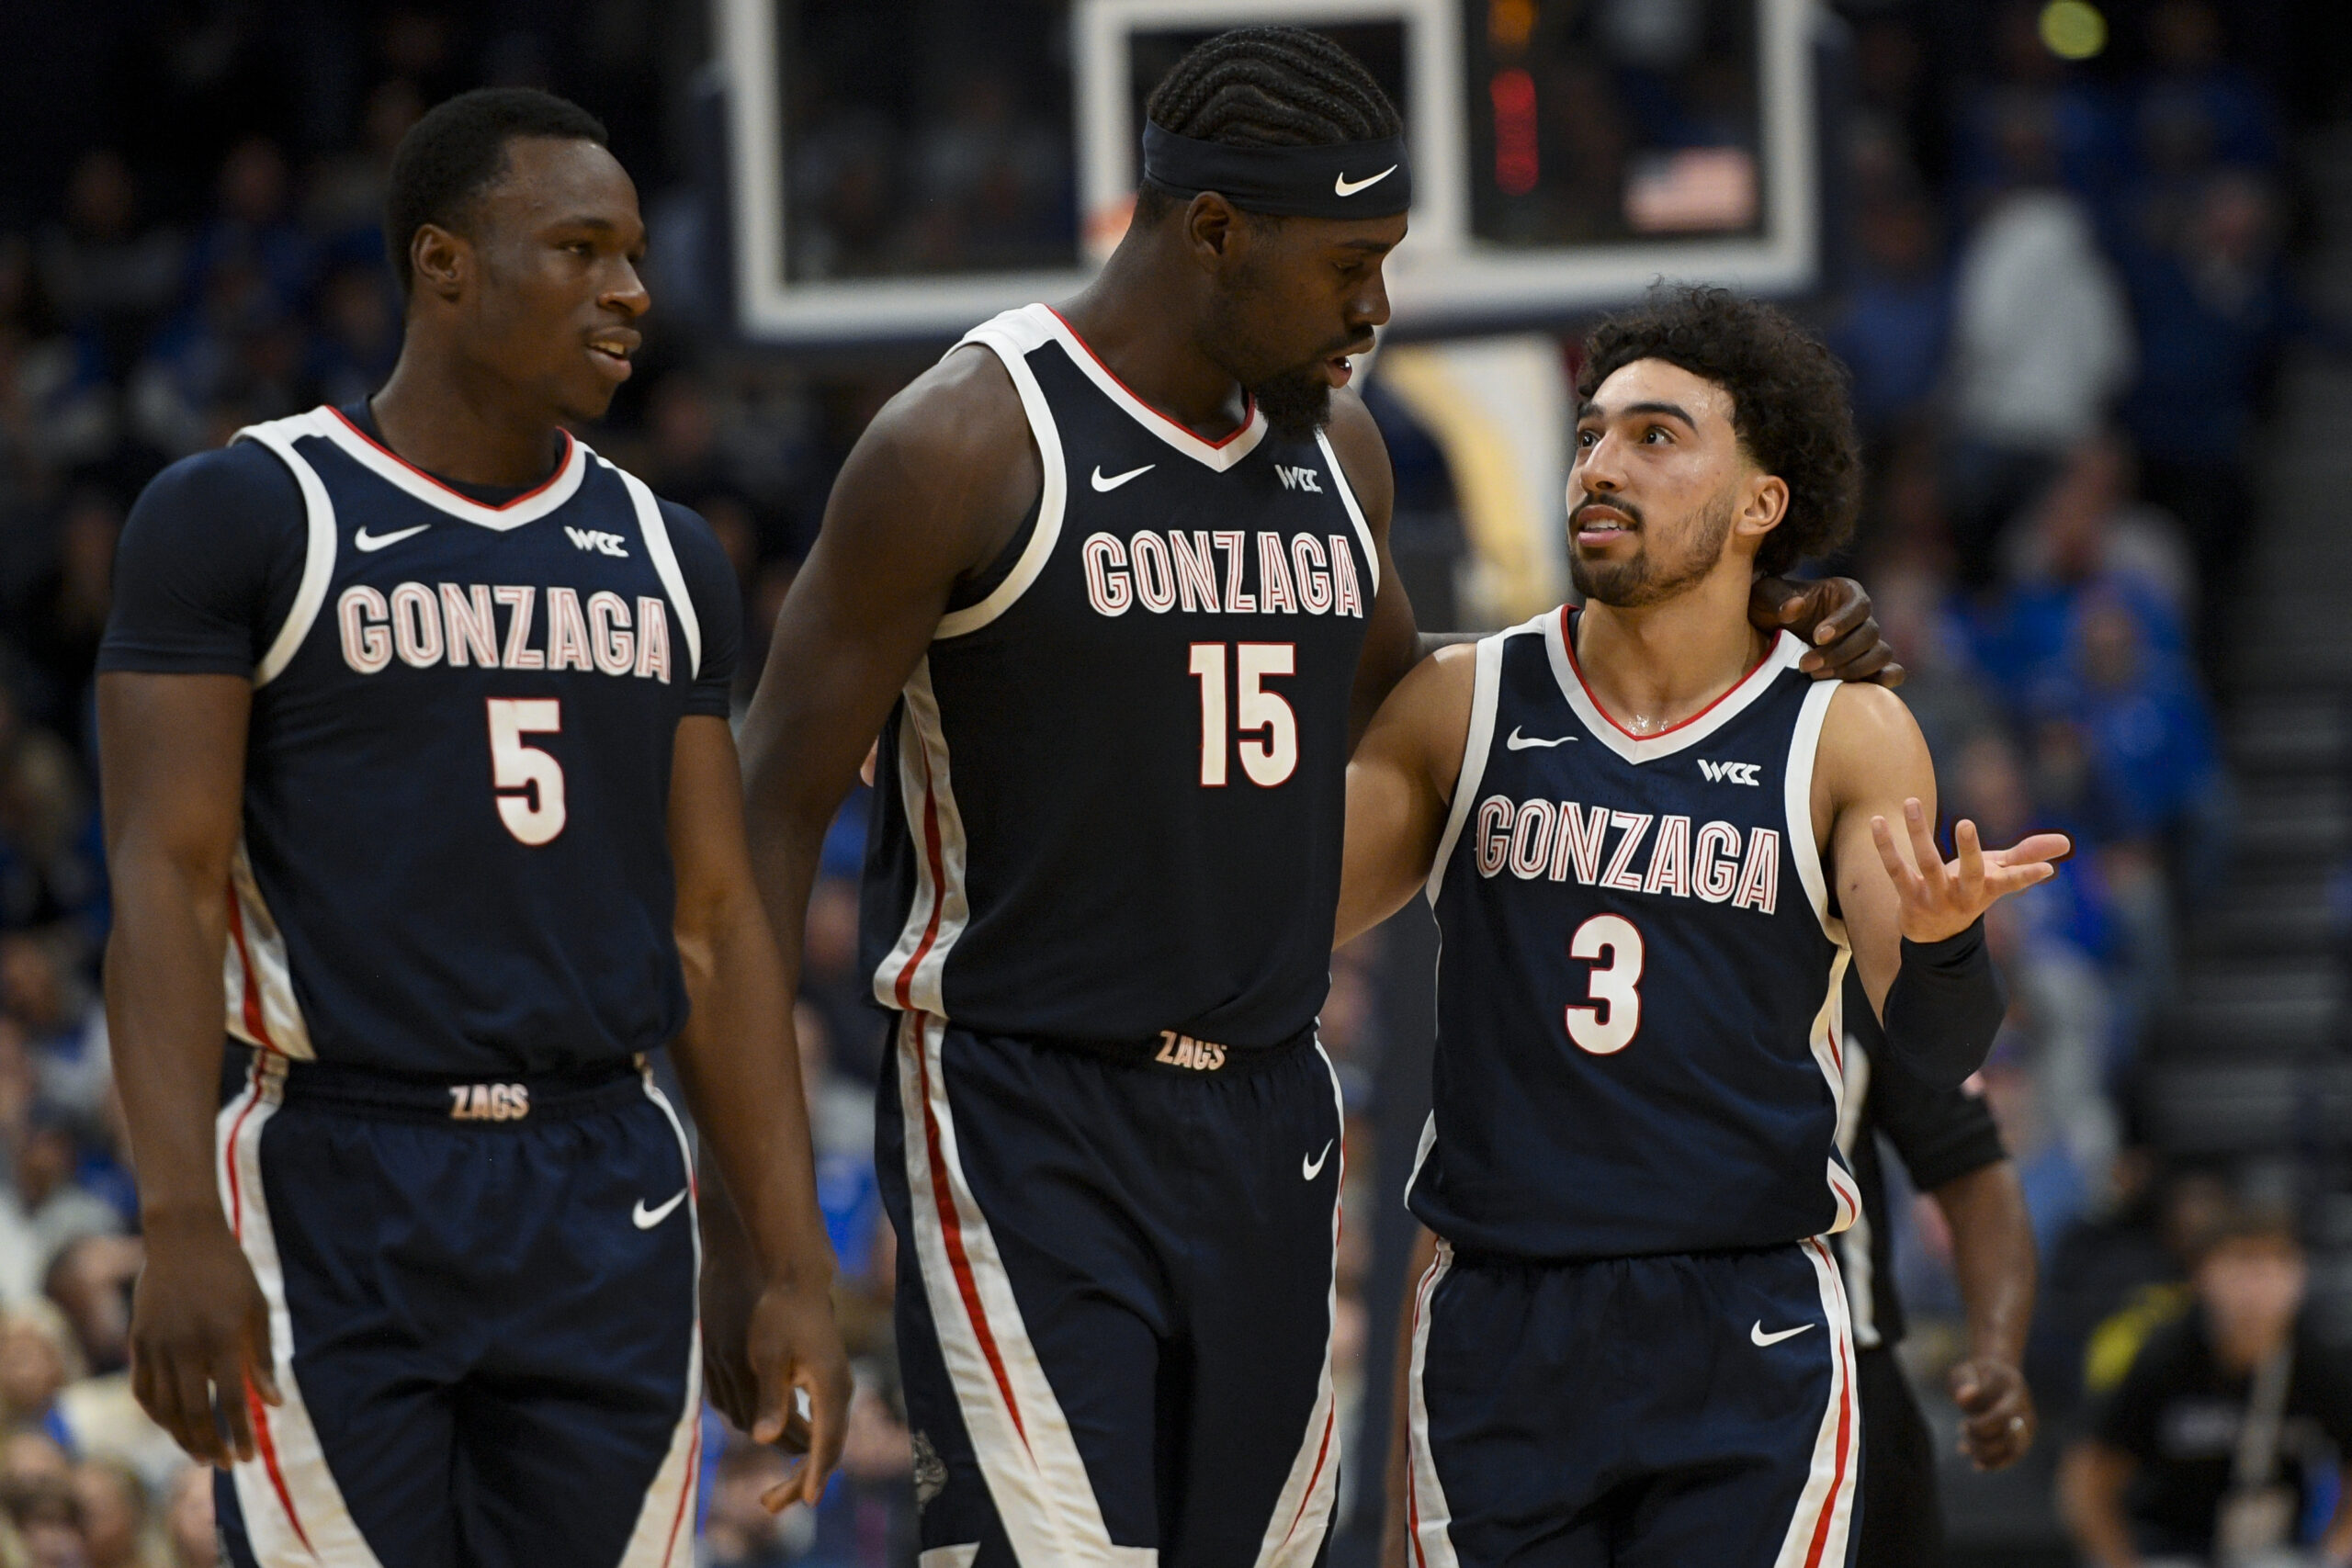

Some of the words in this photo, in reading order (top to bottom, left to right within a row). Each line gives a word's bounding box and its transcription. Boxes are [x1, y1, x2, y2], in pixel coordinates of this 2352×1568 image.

[1274, 464, 1323, 494] WCC
[1082, 529, 1363, 618] GONZAGA
[336, 582, 671, 684] GONZAGA
[1188, 641, 1299, 788] 15
[485, 696, 567, 846] 5
[1697, 759, 1761, 786] WCC
[1475, 795, 1780, 915] GONZAGA
[1565, 912, 1645, 1055] 3
[1155, 1029, 1228, 1071] ZAGS
[448, 1083, 530, 1122] ZAGS
